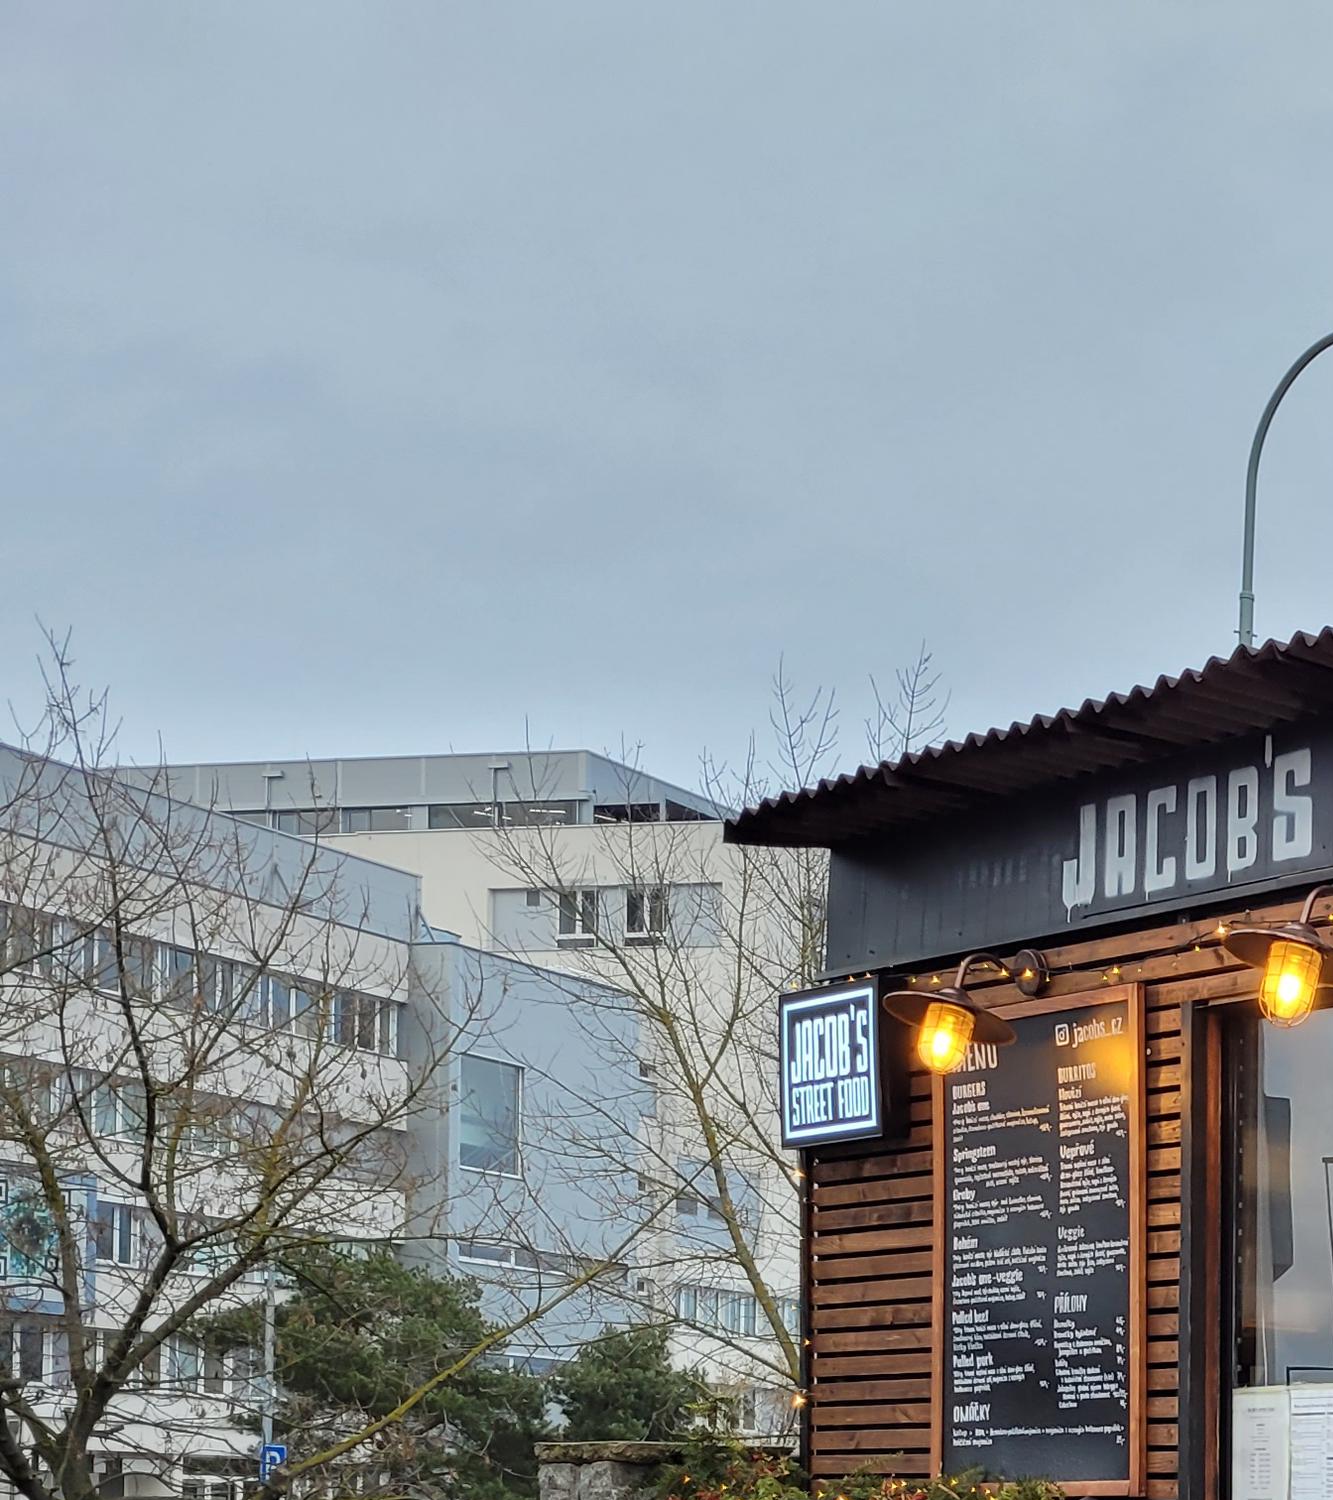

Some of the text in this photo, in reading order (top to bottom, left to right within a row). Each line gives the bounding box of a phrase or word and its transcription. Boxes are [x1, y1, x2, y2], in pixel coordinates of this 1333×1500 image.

[1063, 736, 1311, 922] JACOB'S
[791, 1004, 869, 1083] JACOB'S
[793, 1076, 870, 1126] STREET FOOD
